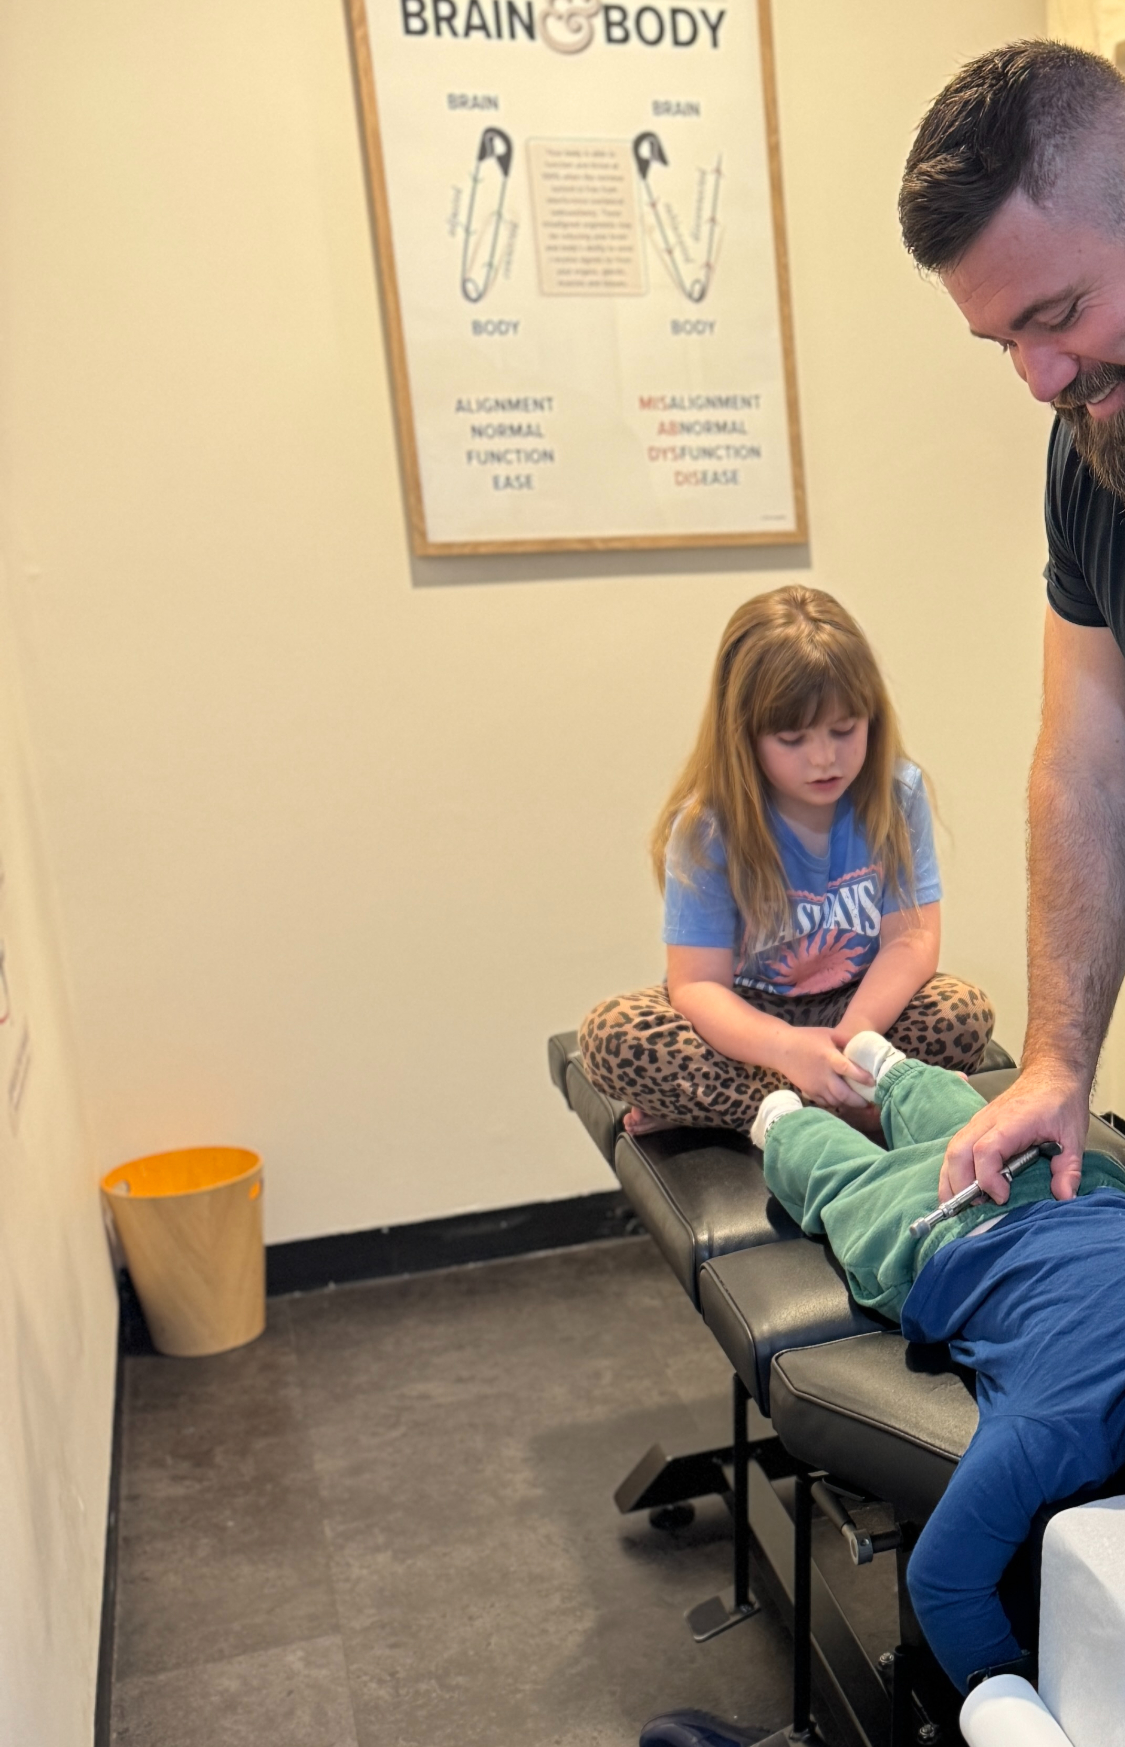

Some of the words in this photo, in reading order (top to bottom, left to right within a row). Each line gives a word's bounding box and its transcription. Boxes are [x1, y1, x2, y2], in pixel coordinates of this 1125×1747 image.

[401, 0, 536, 41] BRAIN
[603, 4, 726, 49] BODY
[446, 93, 499, 111] BRAIN
[651, 99, 701, 117] BRAIN
[471, 319, 520, 337] BODY
[670, 319, 716, 336] BODY
[455, 396, 554, 414] ALIGNMENT
[638, 394, 761, 411] MISALIGNMENT
[470, 423, 543, 439] NORMAL
[657, 420, 748, 436] ABNORMAL
[466, 448, 556, 466] FUNCTION
[647, 444, 762, 462] DYSFUNCTION
[492, 474, 534, 491] EASE
[674, 470, 740, 487] DISEASE
